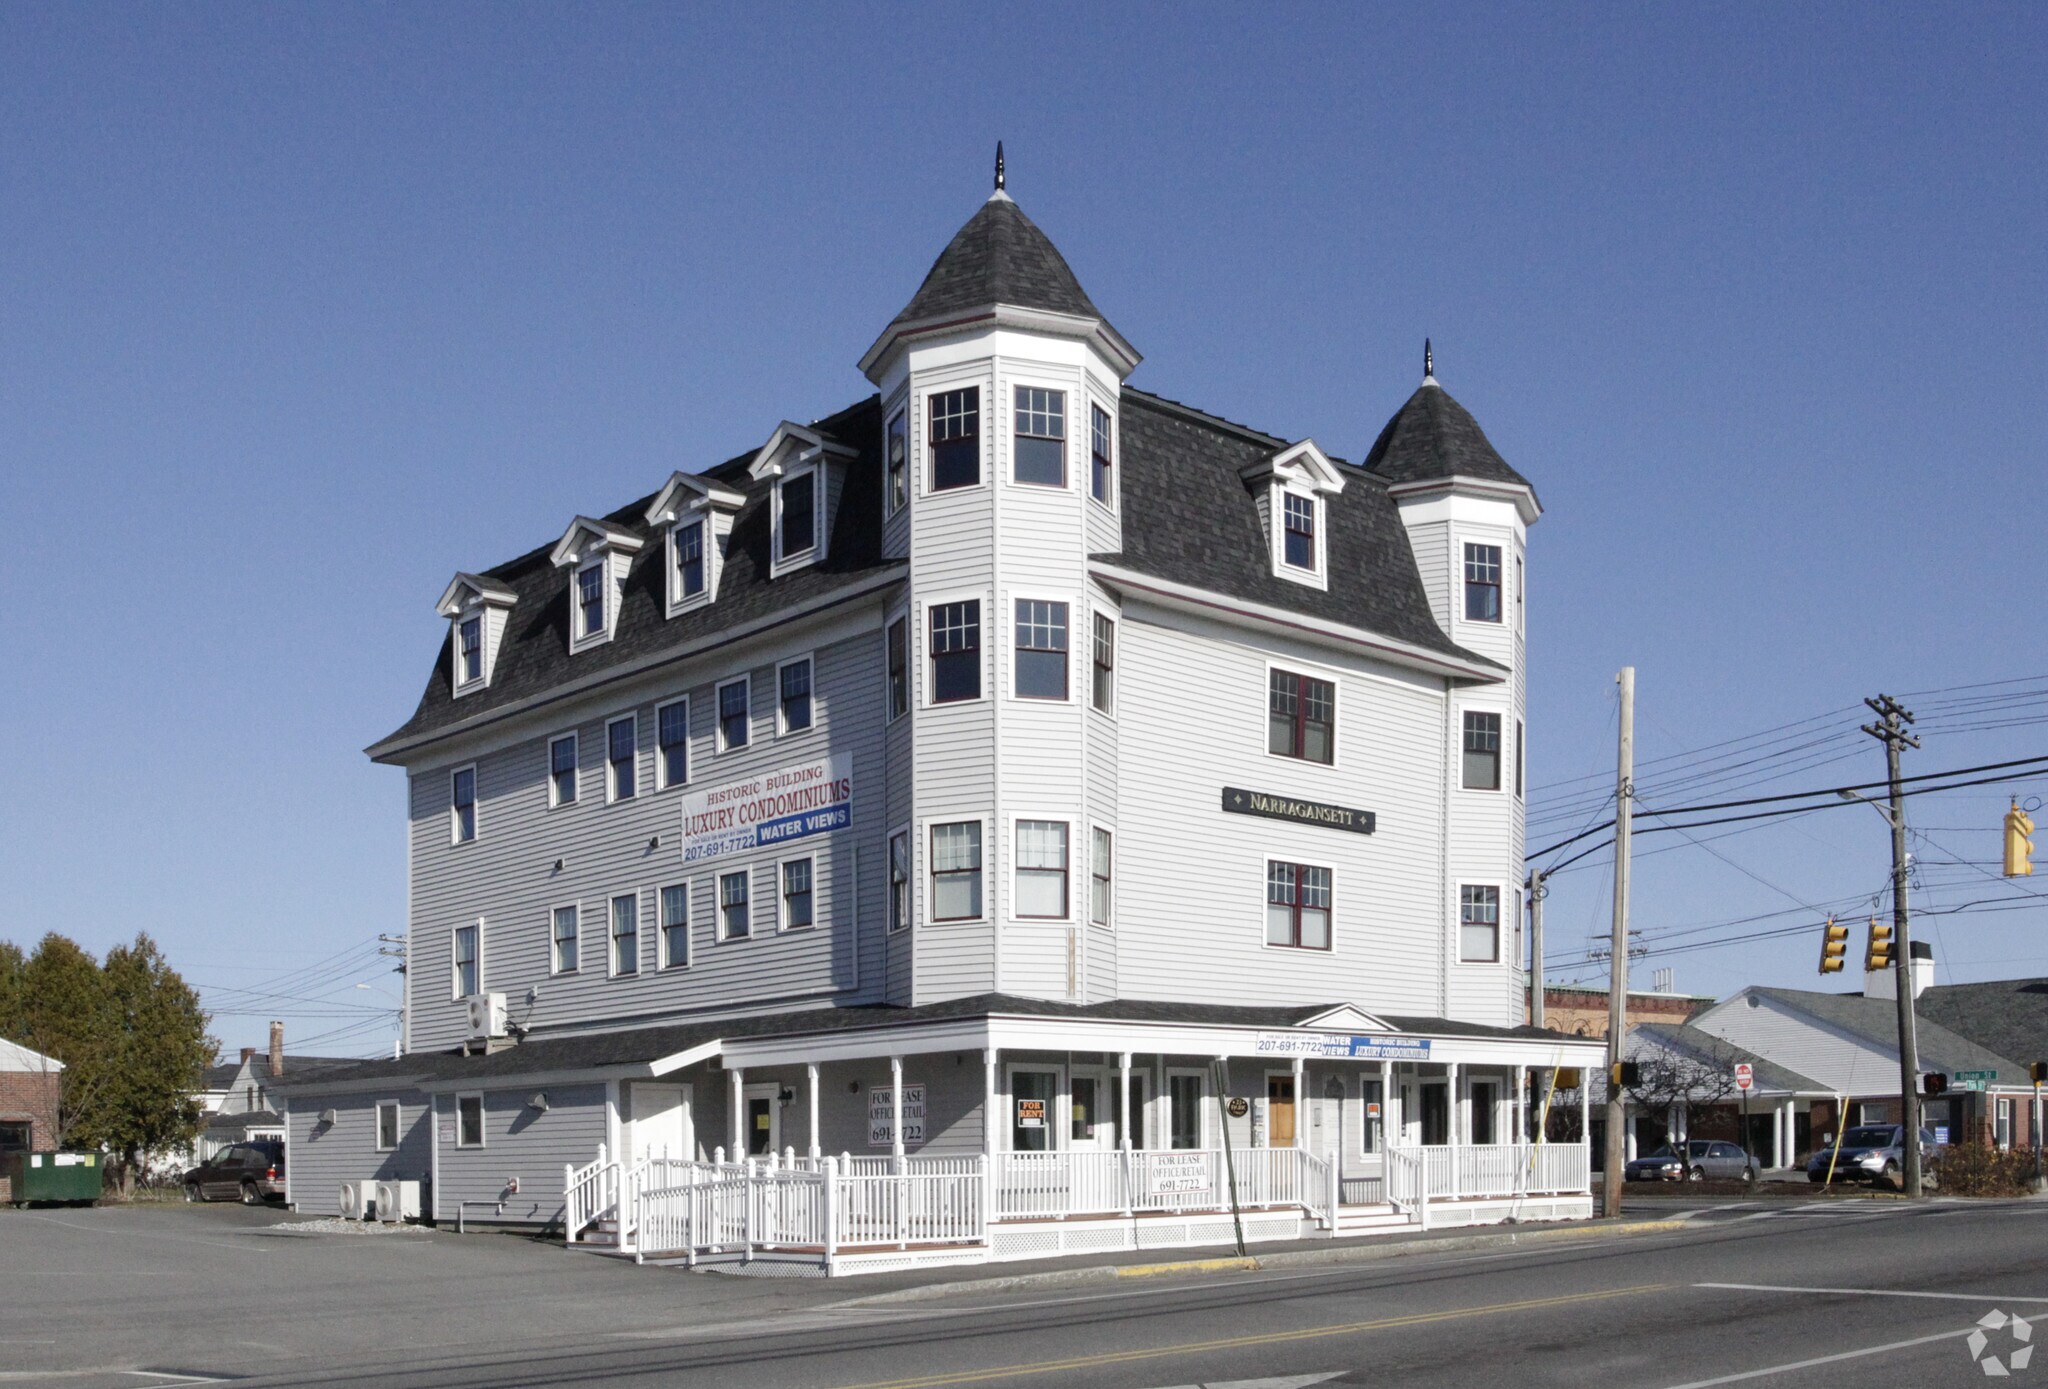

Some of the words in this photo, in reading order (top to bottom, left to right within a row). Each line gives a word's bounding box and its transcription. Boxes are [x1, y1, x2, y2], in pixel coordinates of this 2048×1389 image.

[707, 782, 760, 806] HISTORIC
[766, 765, 823, 791] BUILDING
[685, 806, 735, 837] LUXURY
[739, 778, 850, 824] CONDOMINIUMS
[1250, 793, 1354, 825] NARRAGANSETT
[761, 822, 802, 841] WATER
[806, 810, 846, 831] VIEWS
[685, 834, 755, 861] 207-691-7722
[1258, 1040, 1323, 1052] 207-691-7722
[1323, 1035, 1351, 1046] WATER
[1322, 1046, 1350, 1056] VIEWS
[1355, 1045, 1381, 1057] LUXURY
[1382, 1046, 1429, 1059] CONDOMINIUMS
[1960, 1071, 1980, 1080] Union
[1985, 1071, 1992, 1079] St
[872, 1092, 891, 1104] FOR
[1023, 1101, 1041, 1110] FOR
[1020, 1109, 1044, 1118] RENT
[872, 1126, 922, 1141] 691-722
[1158, 1156, 1175, 1166] FOR
[1177, 1155, 1200, 1165] LEASE
[1152, 1166, 1206, 1178] OFFICE/RETAIL
[1160, 1178, 1200, 1191] 691-7722
